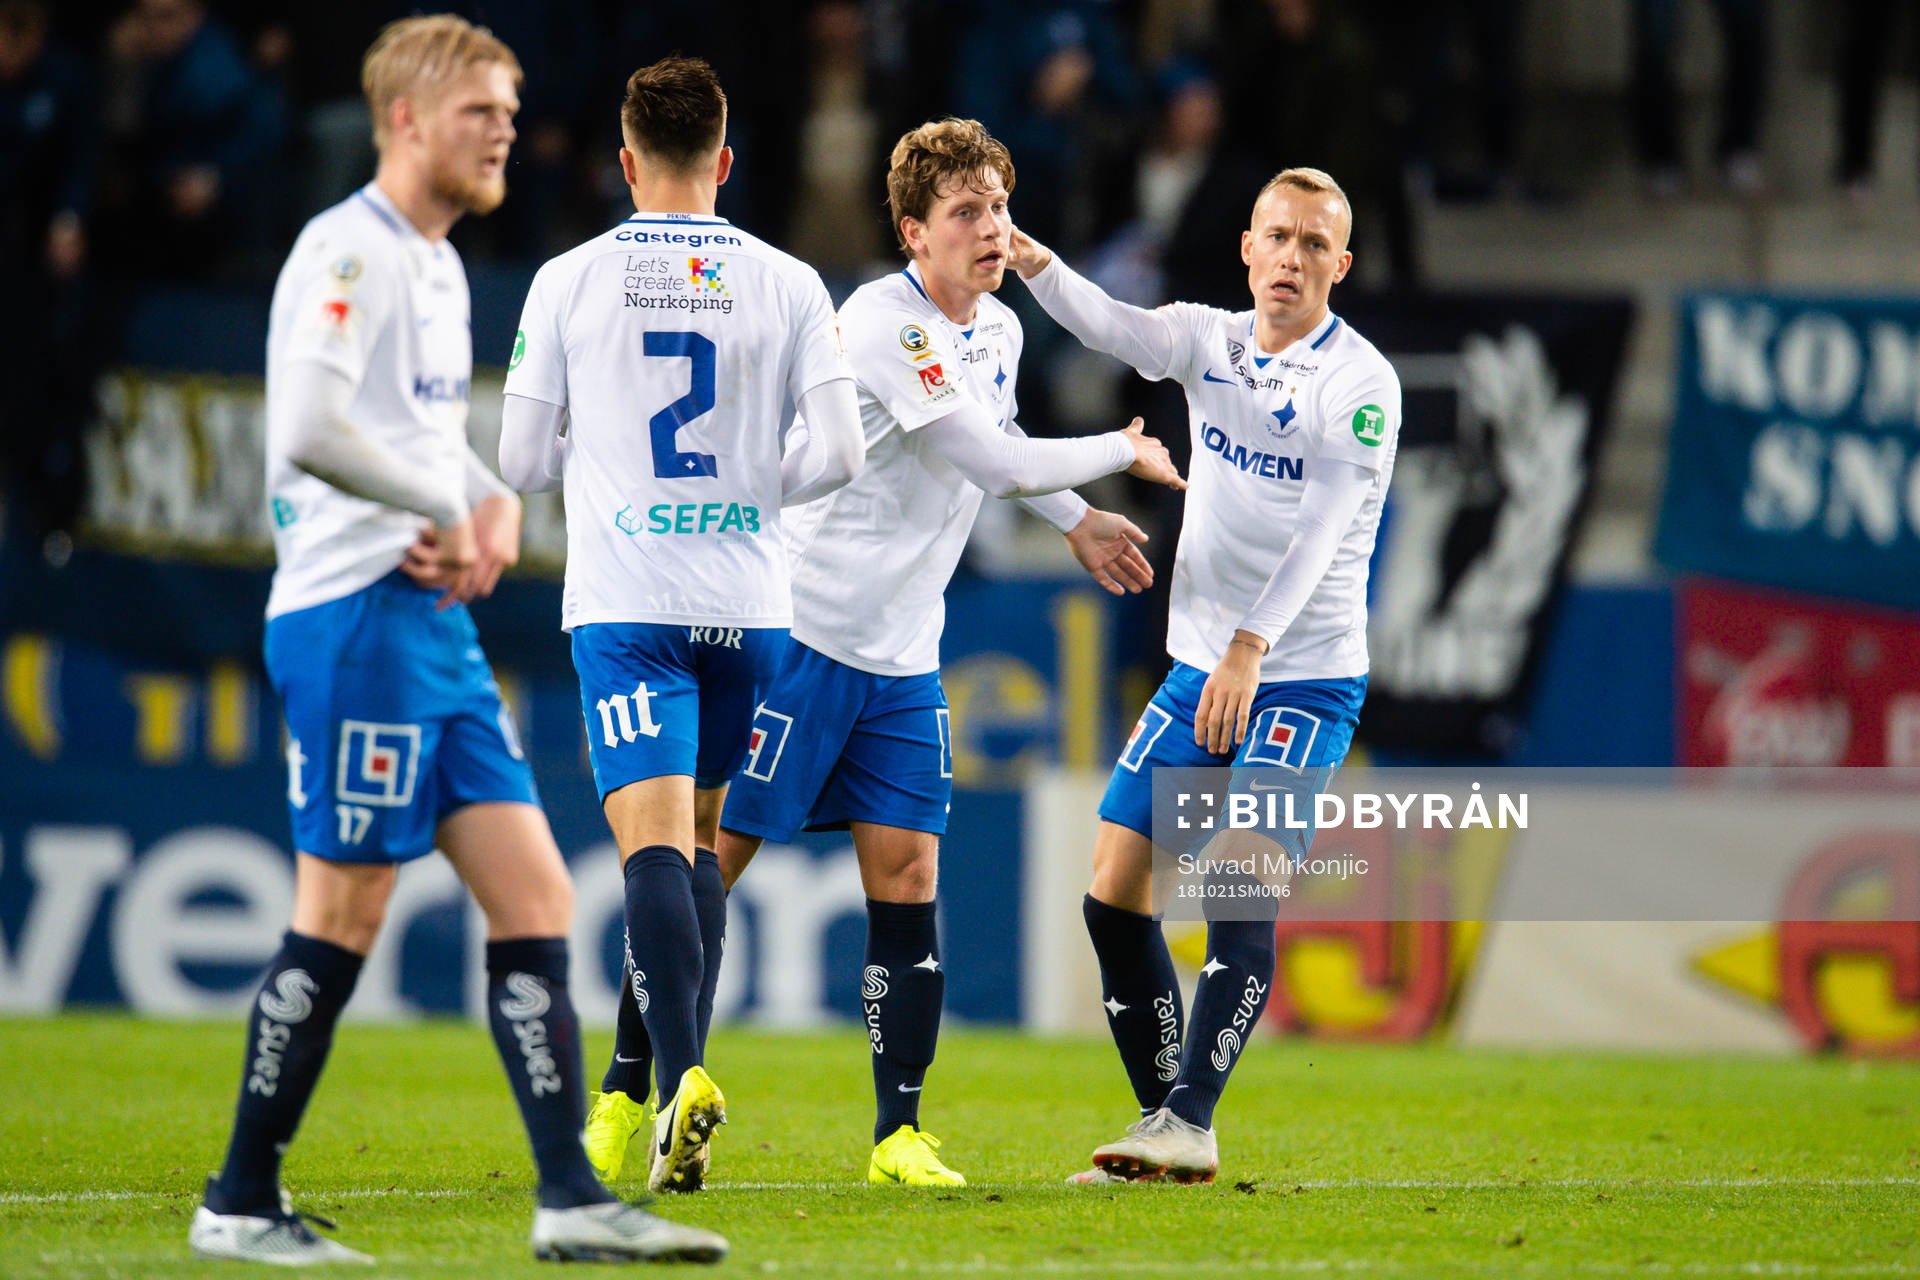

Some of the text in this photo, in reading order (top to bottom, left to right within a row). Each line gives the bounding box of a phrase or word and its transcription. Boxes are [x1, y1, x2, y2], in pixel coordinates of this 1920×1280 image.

[666, 213, 692, 221] PEKING
[615, 231, 742, 248] Castegren
[624, 255, 670, 274] Let's
[624, 275, 685, 291] create
[624, 292, 734, 314] Norrköping
[642, 331, 719, 479] 2
[648, 502, 761, 534] SEFAB
[335, 804, 374, 846] 17
[1153, 990, 1178, 1045] suez
[1232, 975, 1267, 1033] suez
[864, 1001, 884, 1055] suez
[248, 1016, 291, 1098] suez
[512, 1017, 562, 1099] suez
